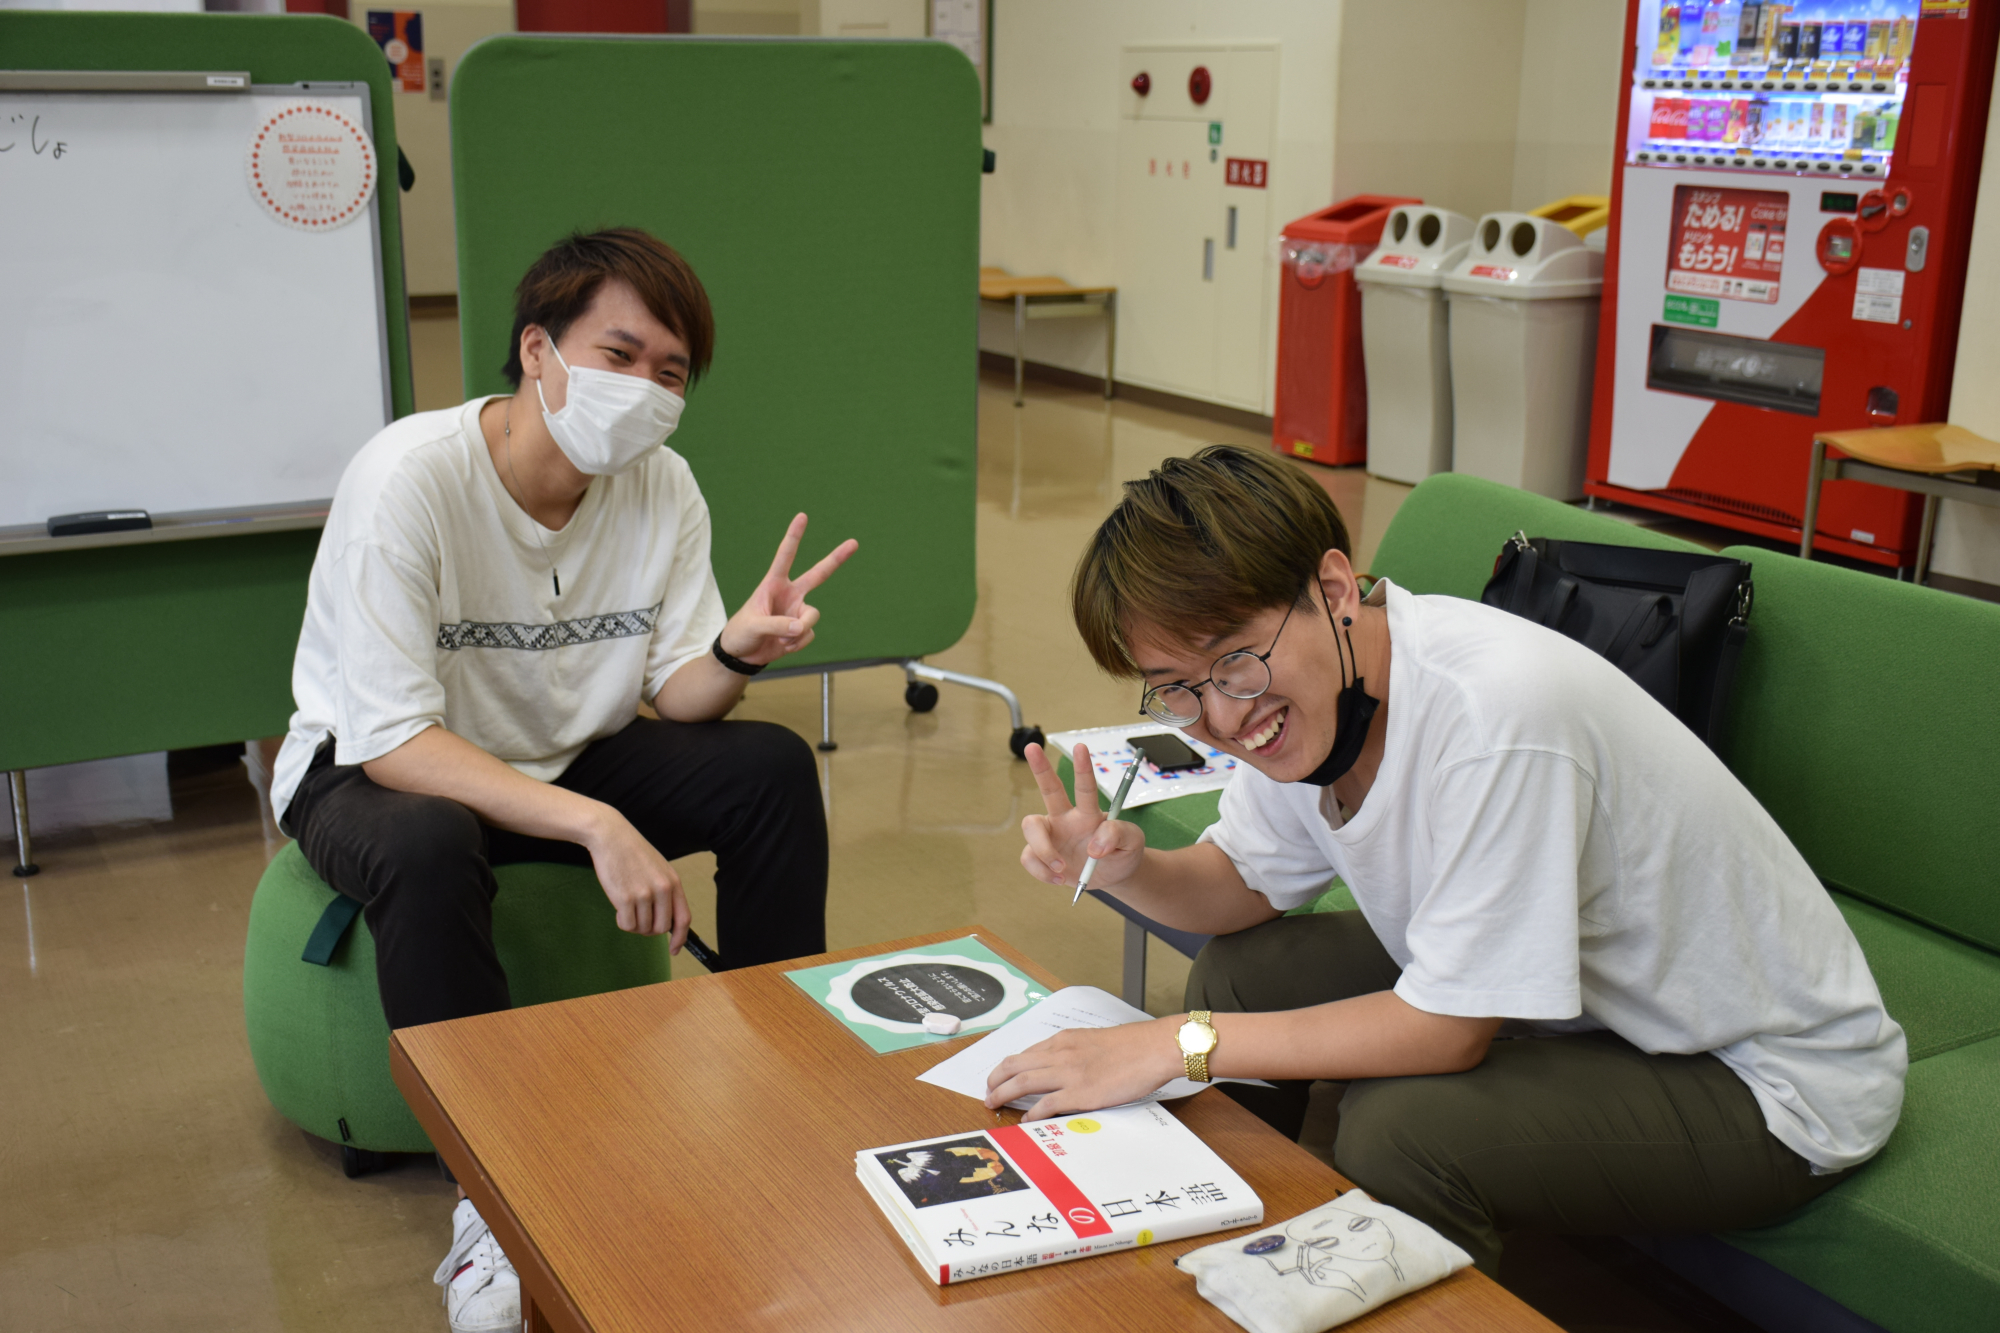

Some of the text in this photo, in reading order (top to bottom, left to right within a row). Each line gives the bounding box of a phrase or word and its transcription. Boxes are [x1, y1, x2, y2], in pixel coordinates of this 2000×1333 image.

[953, 1253, 1038, 1278] みんなの日本語
